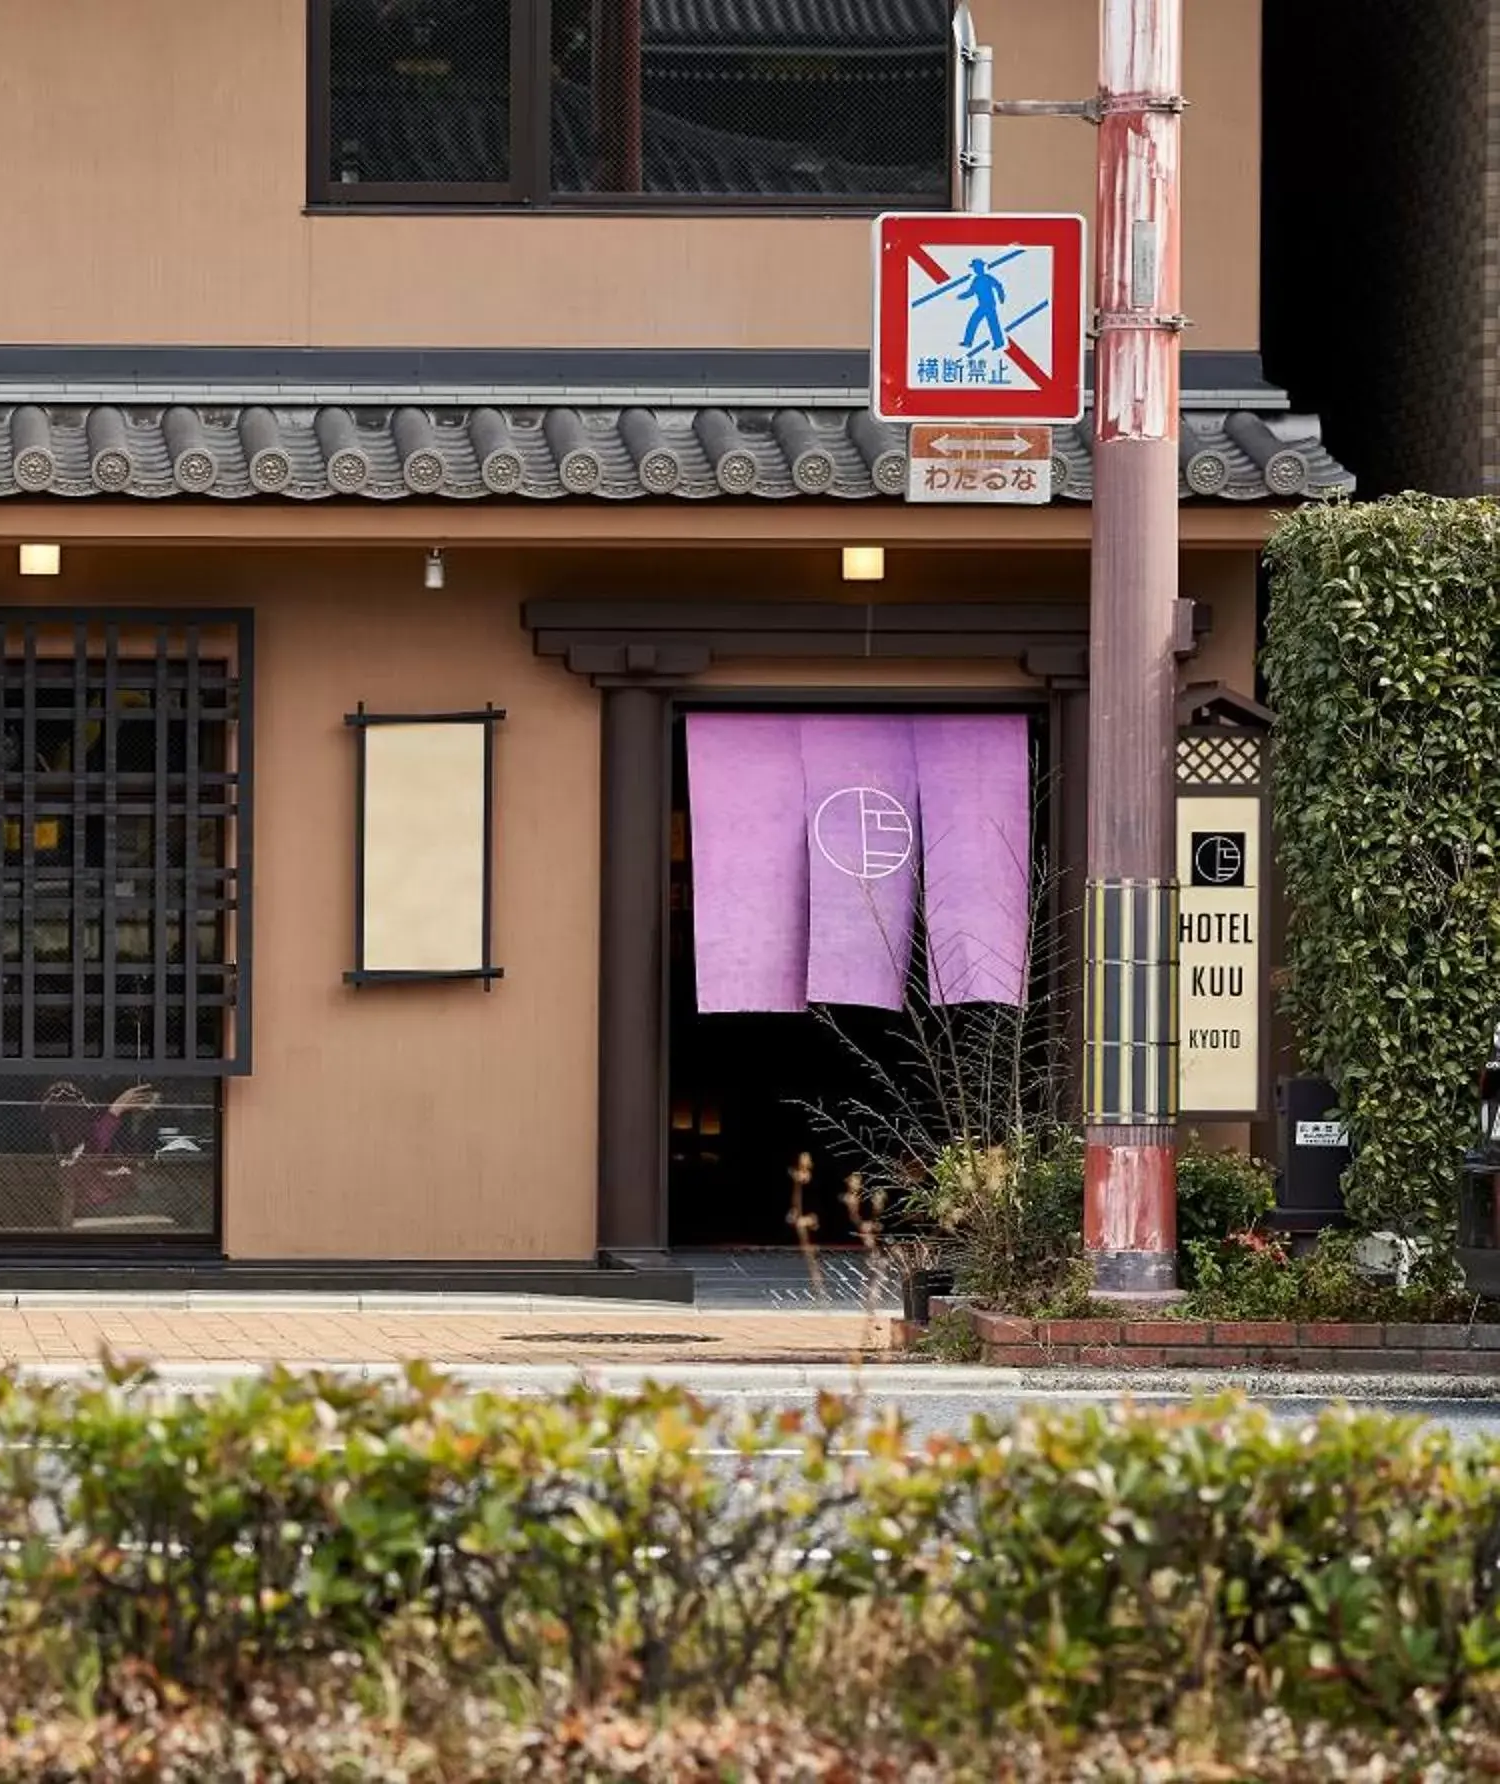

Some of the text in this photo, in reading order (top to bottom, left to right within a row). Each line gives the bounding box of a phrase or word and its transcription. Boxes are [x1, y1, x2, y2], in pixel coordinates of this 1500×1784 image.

[917, 357, 1011, 384] 横断禁止
[924, 465, 1037, 491] わたるな
[1179, 913, 1253, 943] HOTEL
[1192, 966, 1243, 996] KUU
[1189, 1029, 1241, 1049] KYOTO
